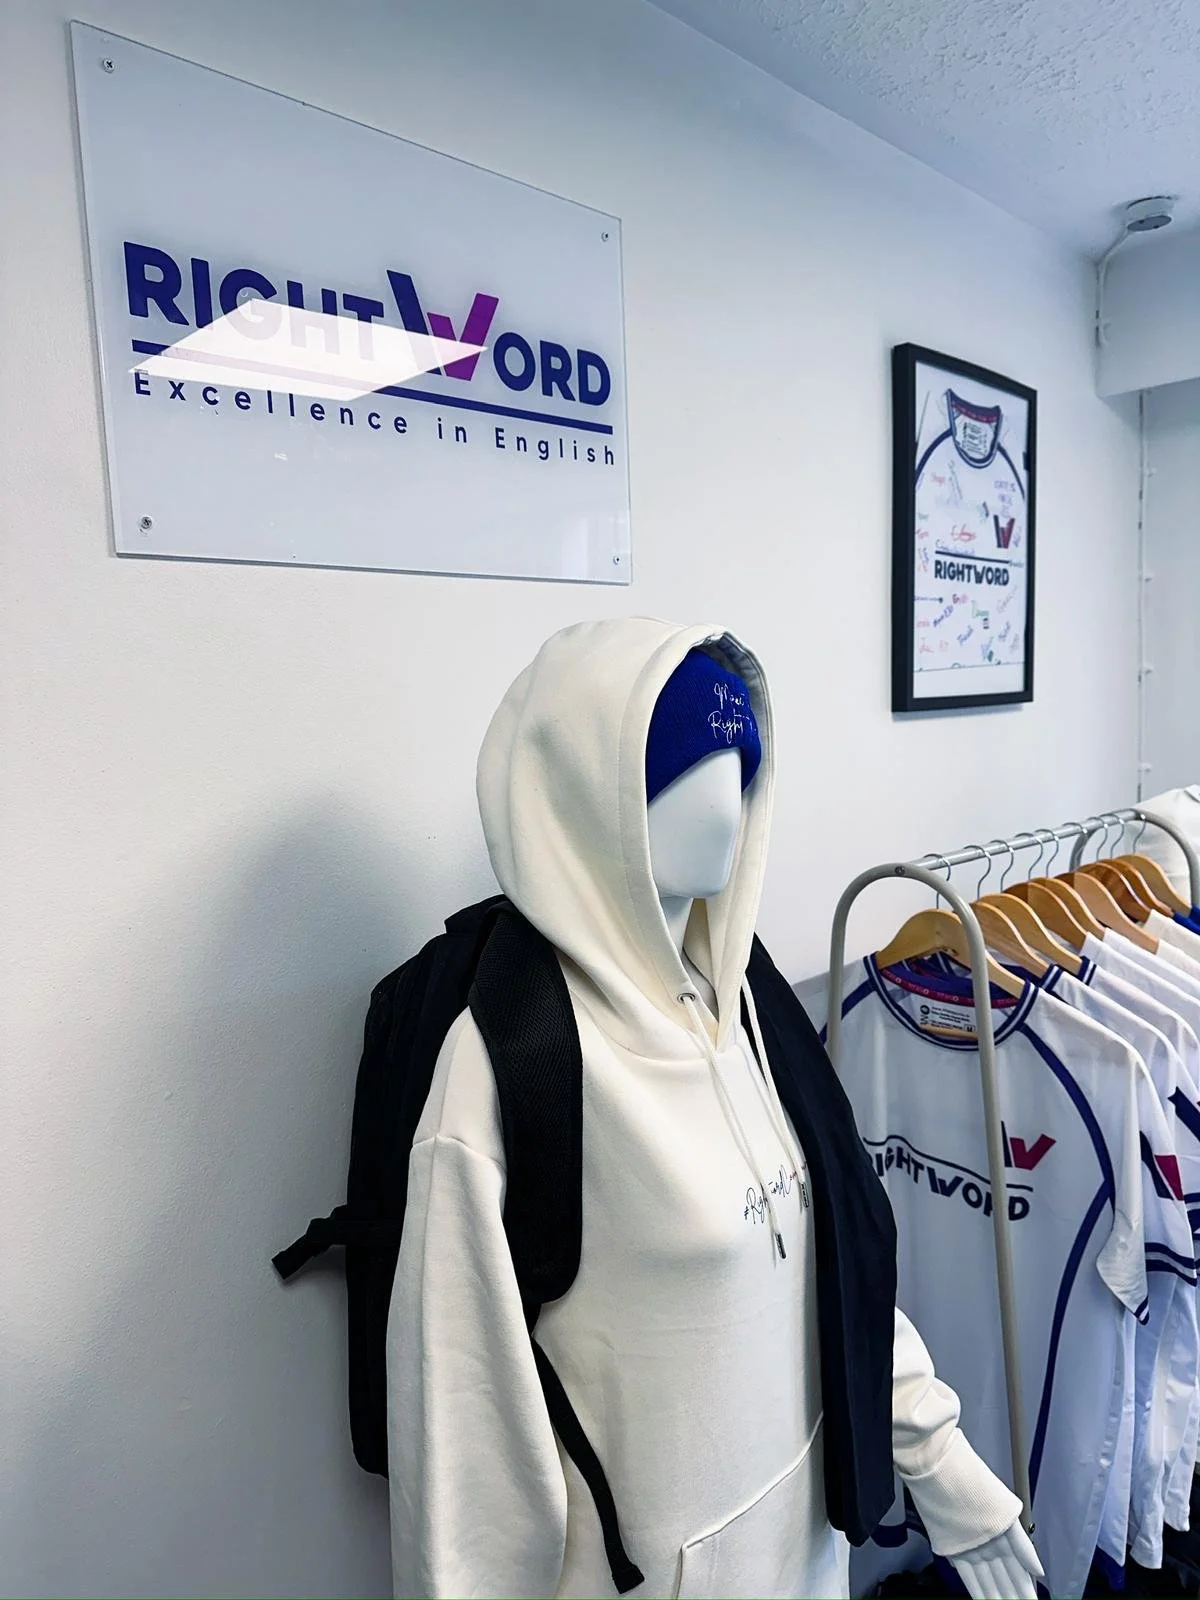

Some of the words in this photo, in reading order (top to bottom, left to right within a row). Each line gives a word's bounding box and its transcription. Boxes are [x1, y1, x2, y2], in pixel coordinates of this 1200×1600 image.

[124, 241, 611, 407] RIGHTWORD
[134, 371, 407, 434] Excellence
[437, 417, 467, 443] in
[494, 427, 614, 465] English
[934, 559, 1010, 587] RIGHTWORD
[867, 1146, 1030, 1221] IGHTWOD
